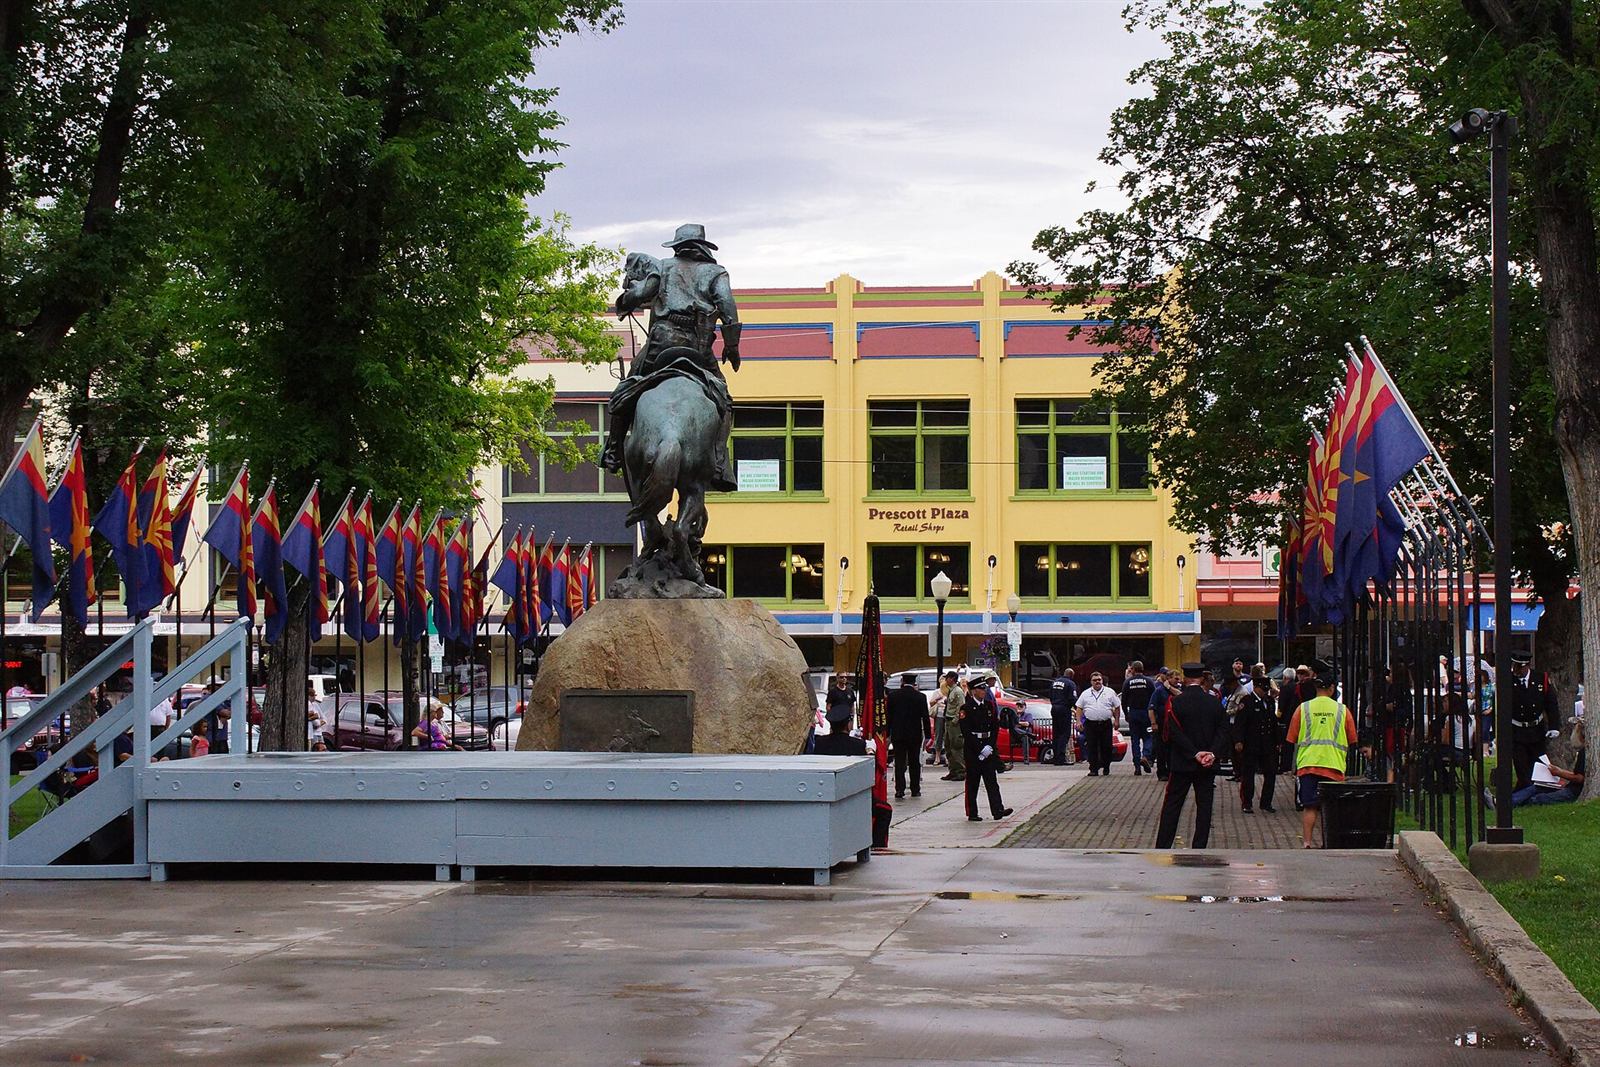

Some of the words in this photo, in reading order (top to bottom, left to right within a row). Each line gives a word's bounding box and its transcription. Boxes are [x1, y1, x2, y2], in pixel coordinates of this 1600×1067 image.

[868, 508, 927, 520] Prescott
[931, 508, 969, 519] Plaza
[893, 524, 918, 532] Retail
[918, 523, 944, 533] Shops
